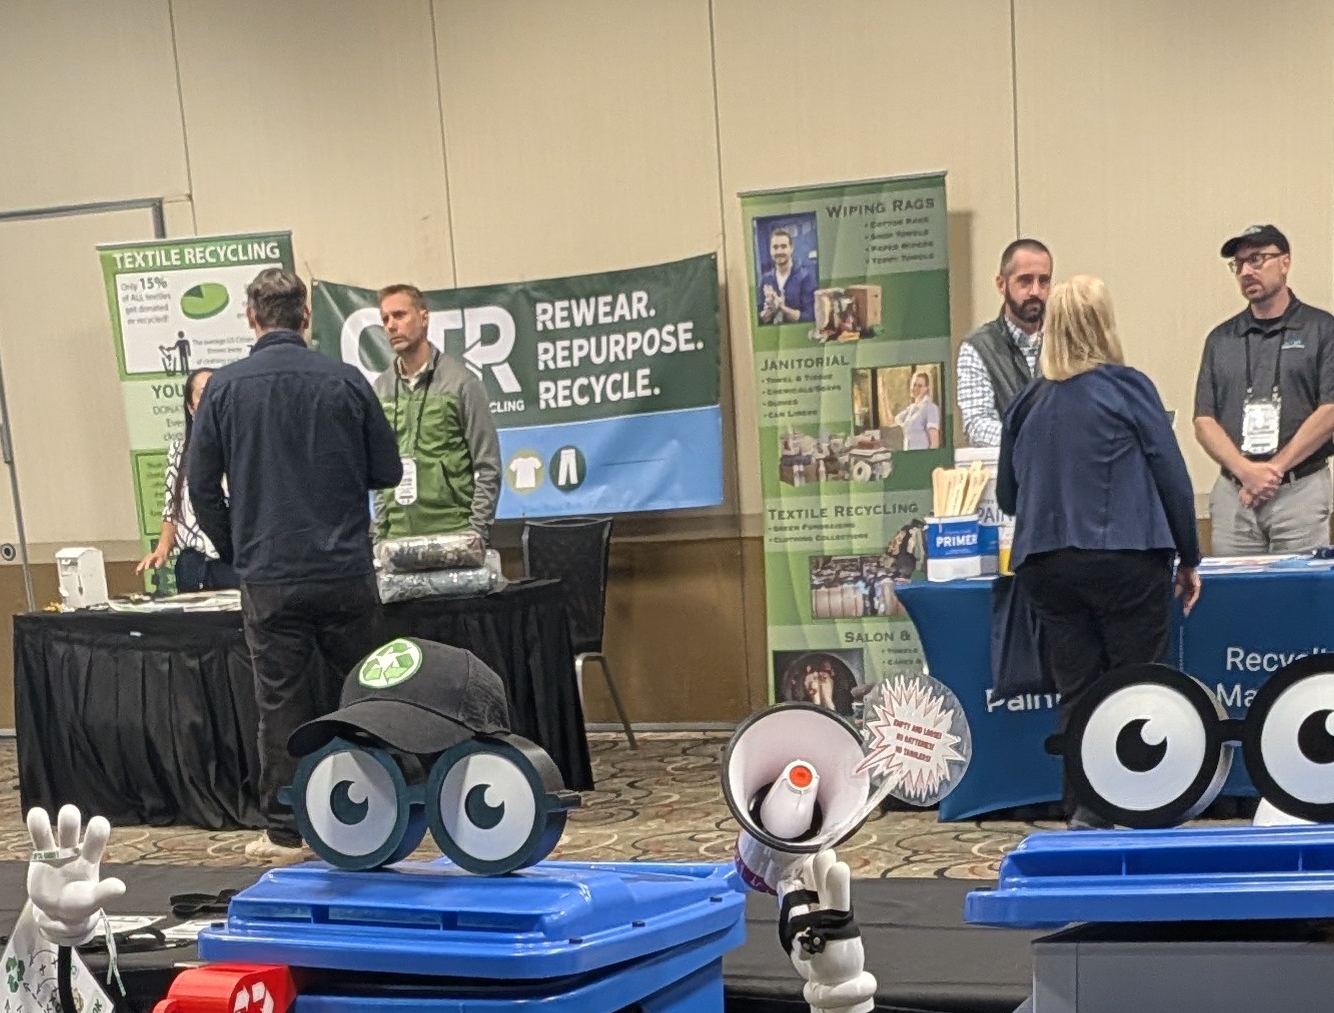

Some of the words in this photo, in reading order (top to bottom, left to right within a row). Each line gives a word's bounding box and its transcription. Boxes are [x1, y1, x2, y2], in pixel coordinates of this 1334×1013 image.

[826, 202, 886, 219] WIPING
[892, 197, 935, 213] RAGS
[113, 248, 181, 271] TEXTILE
[184, 241, 280, 266] RECYCLING
[139, 276, 168, 290] 15%
[139, 303, 169, 313] donated
[535, 290, 656, 332] REWEAR.
[537, 321, 705, 371] REPURPOSE.
[760, 355, 850, 372] JANITORIAL
[538, 367, 661, 411] RECYCLE.
[768, 507, 828, 521] TEXTILE
[834, 503, 918, 518] RECYCLING
[935, 533, 978, 548] PRIMER
[844, 631, 894, 643] SALON
[900, 630, 911, 642] &
